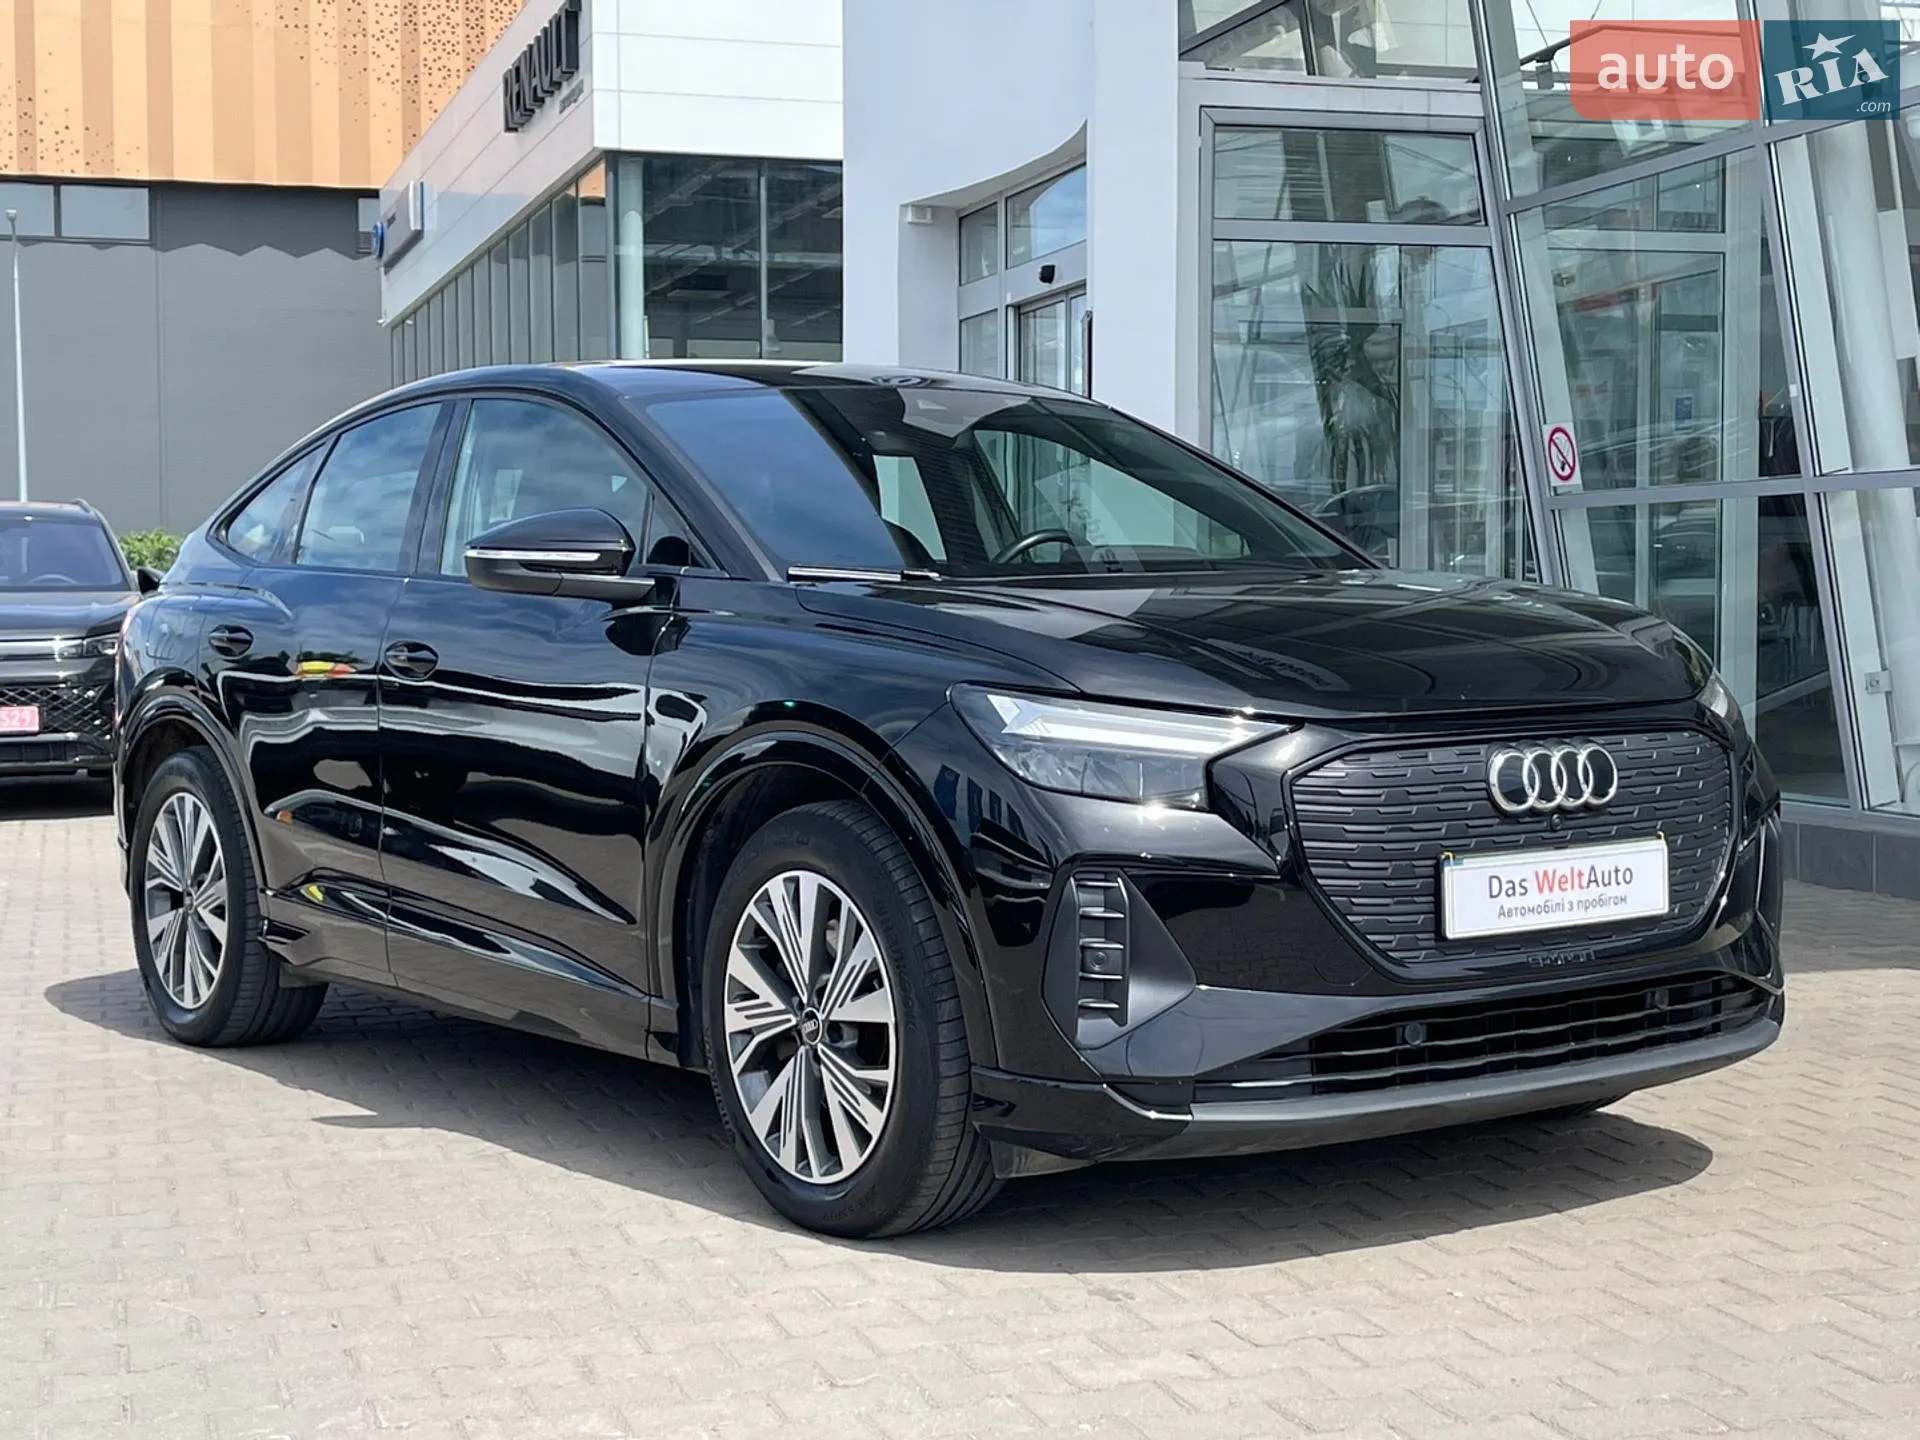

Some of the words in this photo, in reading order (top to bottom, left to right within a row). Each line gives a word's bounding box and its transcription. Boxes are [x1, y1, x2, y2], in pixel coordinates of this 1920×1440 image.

[503, 0, 582, 133] RENAULT
[1488, 875, 1529, 899] Das
[1535, 865, 1634, 895] WeltAuto
[1497, 899, 1565, 919] Автомобілі
[1577, 893, 1628, 913] пробігом
